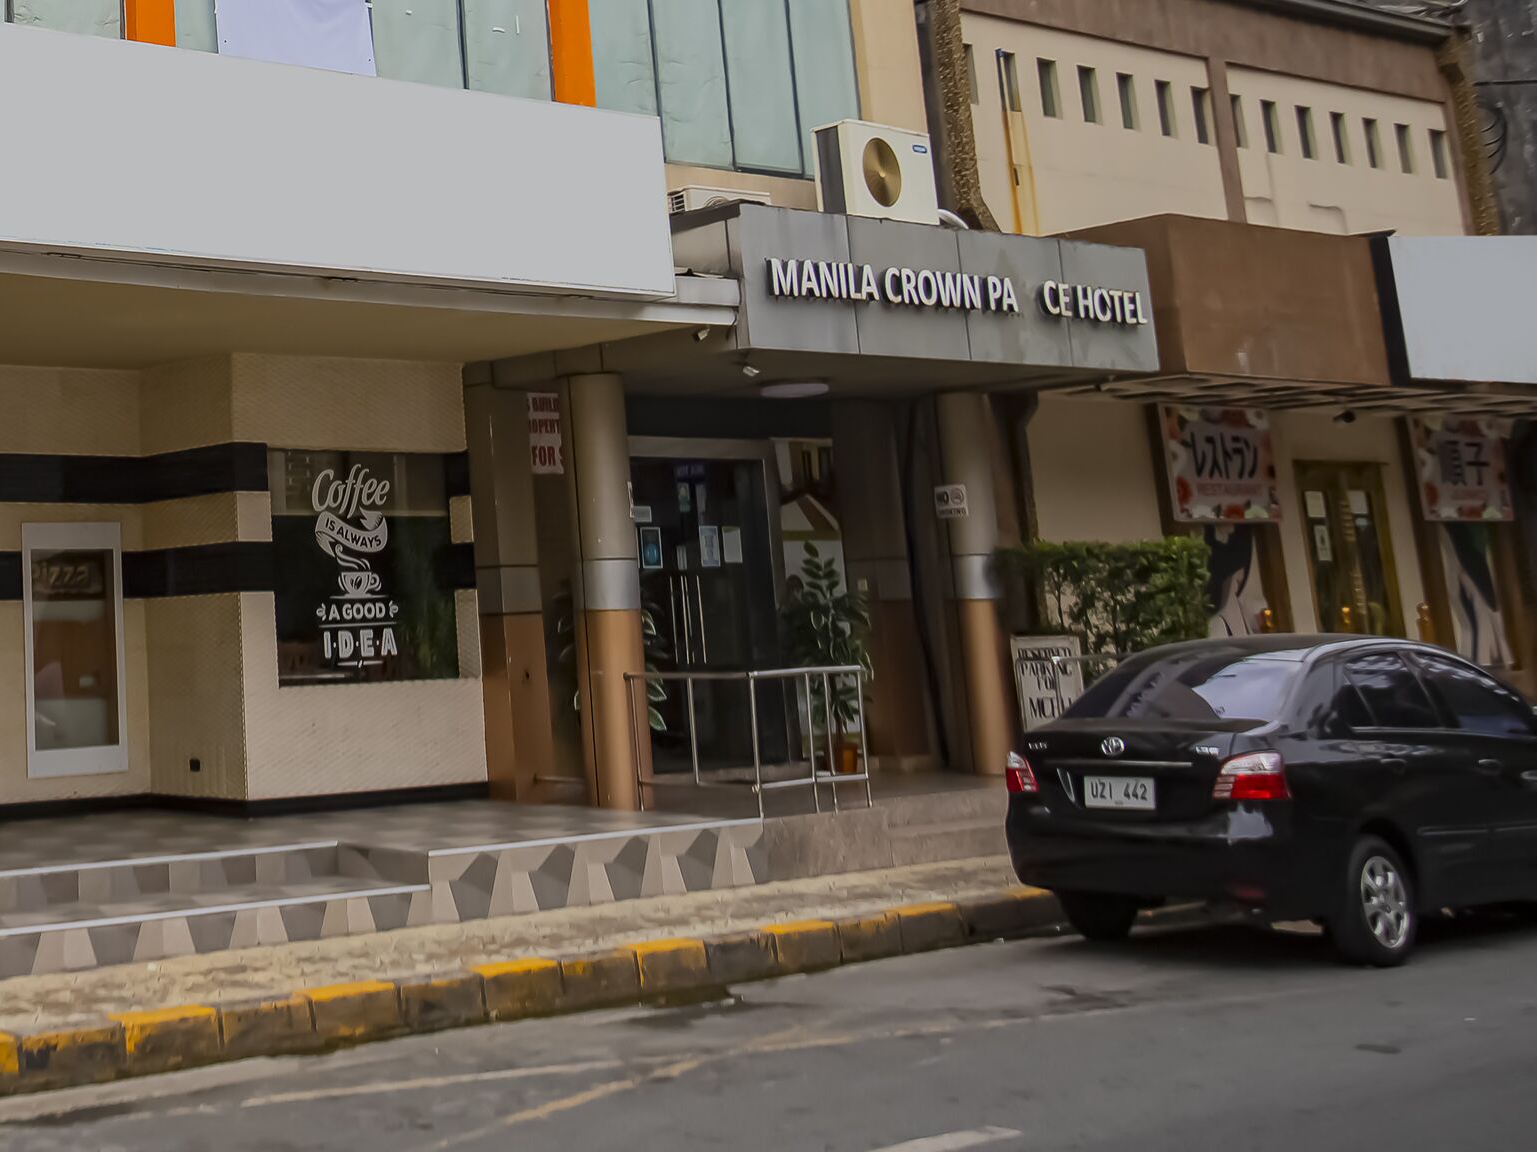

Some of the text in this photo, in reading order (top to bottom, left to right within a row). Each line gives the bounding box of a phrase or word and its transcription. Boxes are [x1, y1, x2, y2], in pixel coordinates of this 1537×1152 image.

[766, 258, 879, 302] MANILA
[884, 266, 982, 311] CROWN
[1076, 285, 1149, 325] HOTEL
[531, 446, 557, 467] FOR
[1190, 432, 1258, 480] レストラン
[312, 463, 390, 519] Coffee
[325, 516, 382, 549] IS ALWAYS
[328, 602, 386, 621] A GOOD
[1123, 782, 1148, 801] 442
